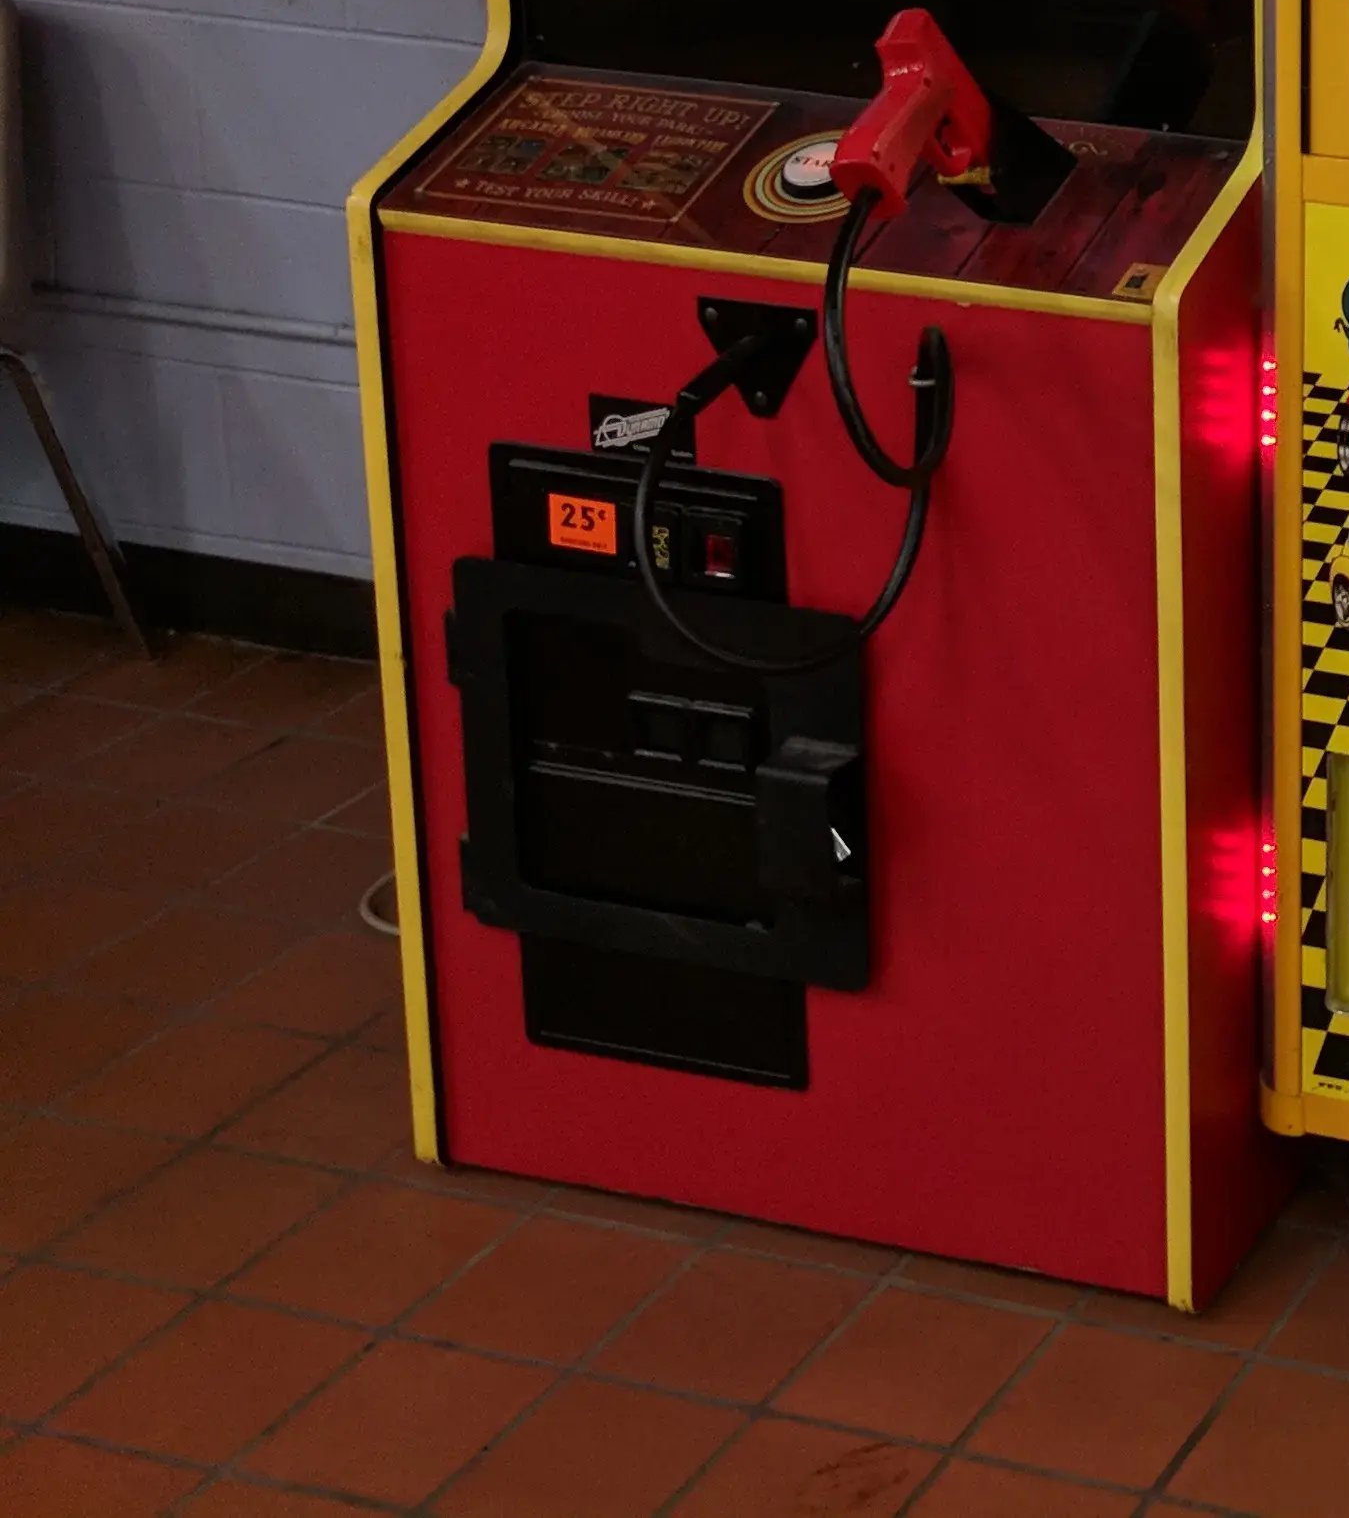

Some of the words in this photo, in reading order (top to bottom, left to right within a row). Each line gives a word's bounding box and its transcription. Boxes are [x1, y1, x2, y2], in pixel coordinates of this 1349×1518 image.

[520, 91, 602, 111] STEP
[608, 93, 698, 117] RIGHT
[705, 105, 751, 131] UP!
[474, 181, 515, 197] TEST
[523, 186, 573, 200] YOUR
[561, 503, 606, 532] 25¢
